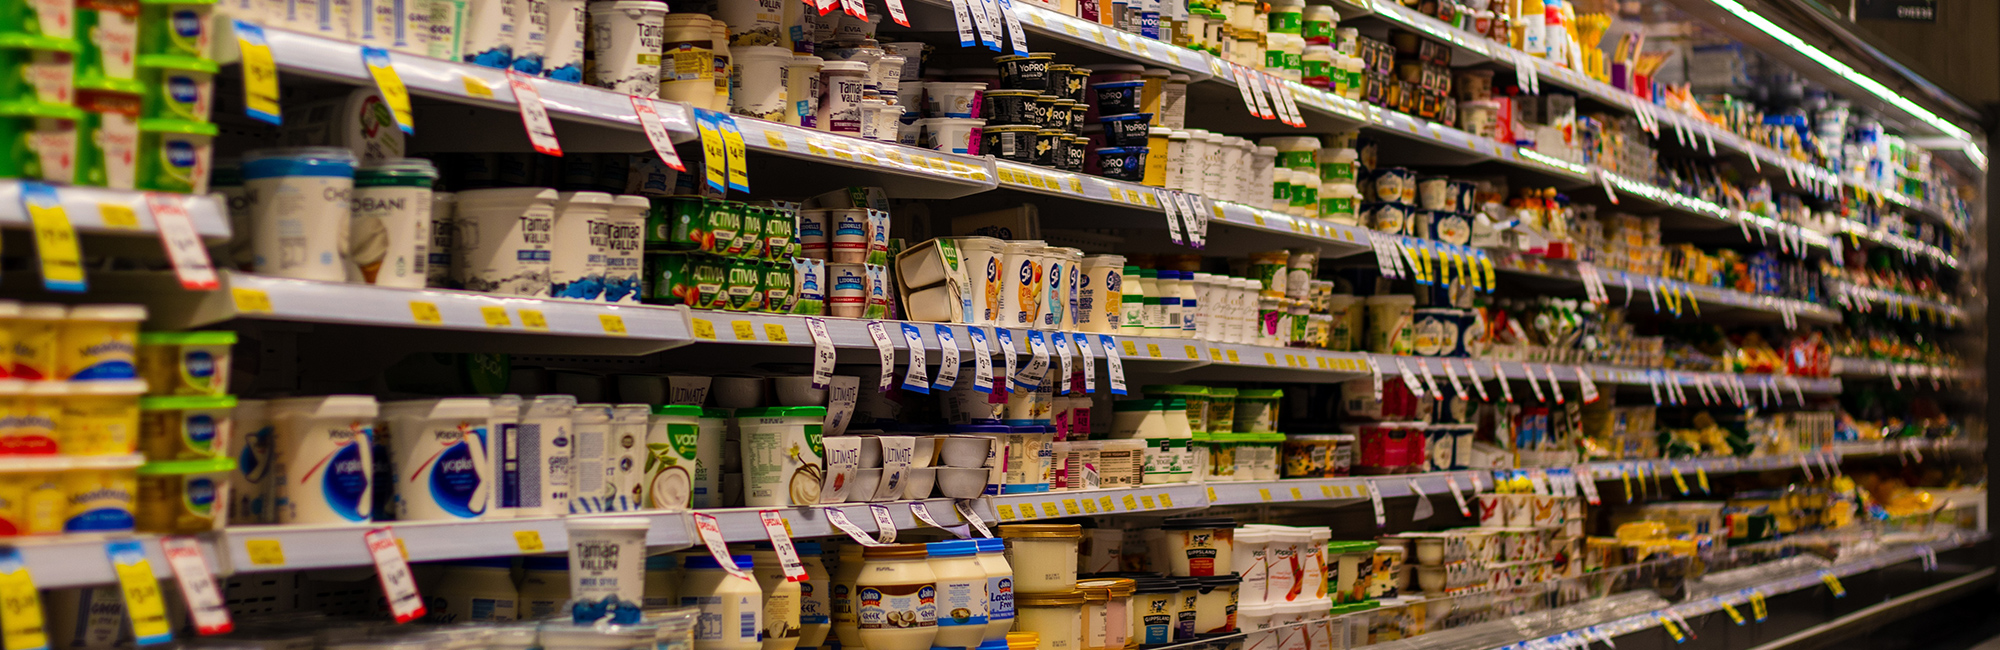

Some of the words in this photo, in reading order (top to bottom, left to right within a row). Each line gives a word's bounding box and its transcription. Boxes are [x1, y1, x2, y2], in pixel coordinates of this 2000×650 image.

[637, 23, 663, 37] Tama
[1019, 64, 1044, 72] YoPRO
[1125, 124, 1147, 132] YoPRO
[708, 211, 740, 230] ACTIVIA
[765, 219, 791, 236] ACTIVIA
[765, 272, 790, 287] ACTIVIA
[831, 386, 857, 403] ULTIMATE
[829, 449, 858, 466] ULTIMATE
[885, 447, 912, 465] ULTIMATE
[1188, 548, 1216, 557] GIPPSLAND
[862, 590, 879, 600] Jalna
